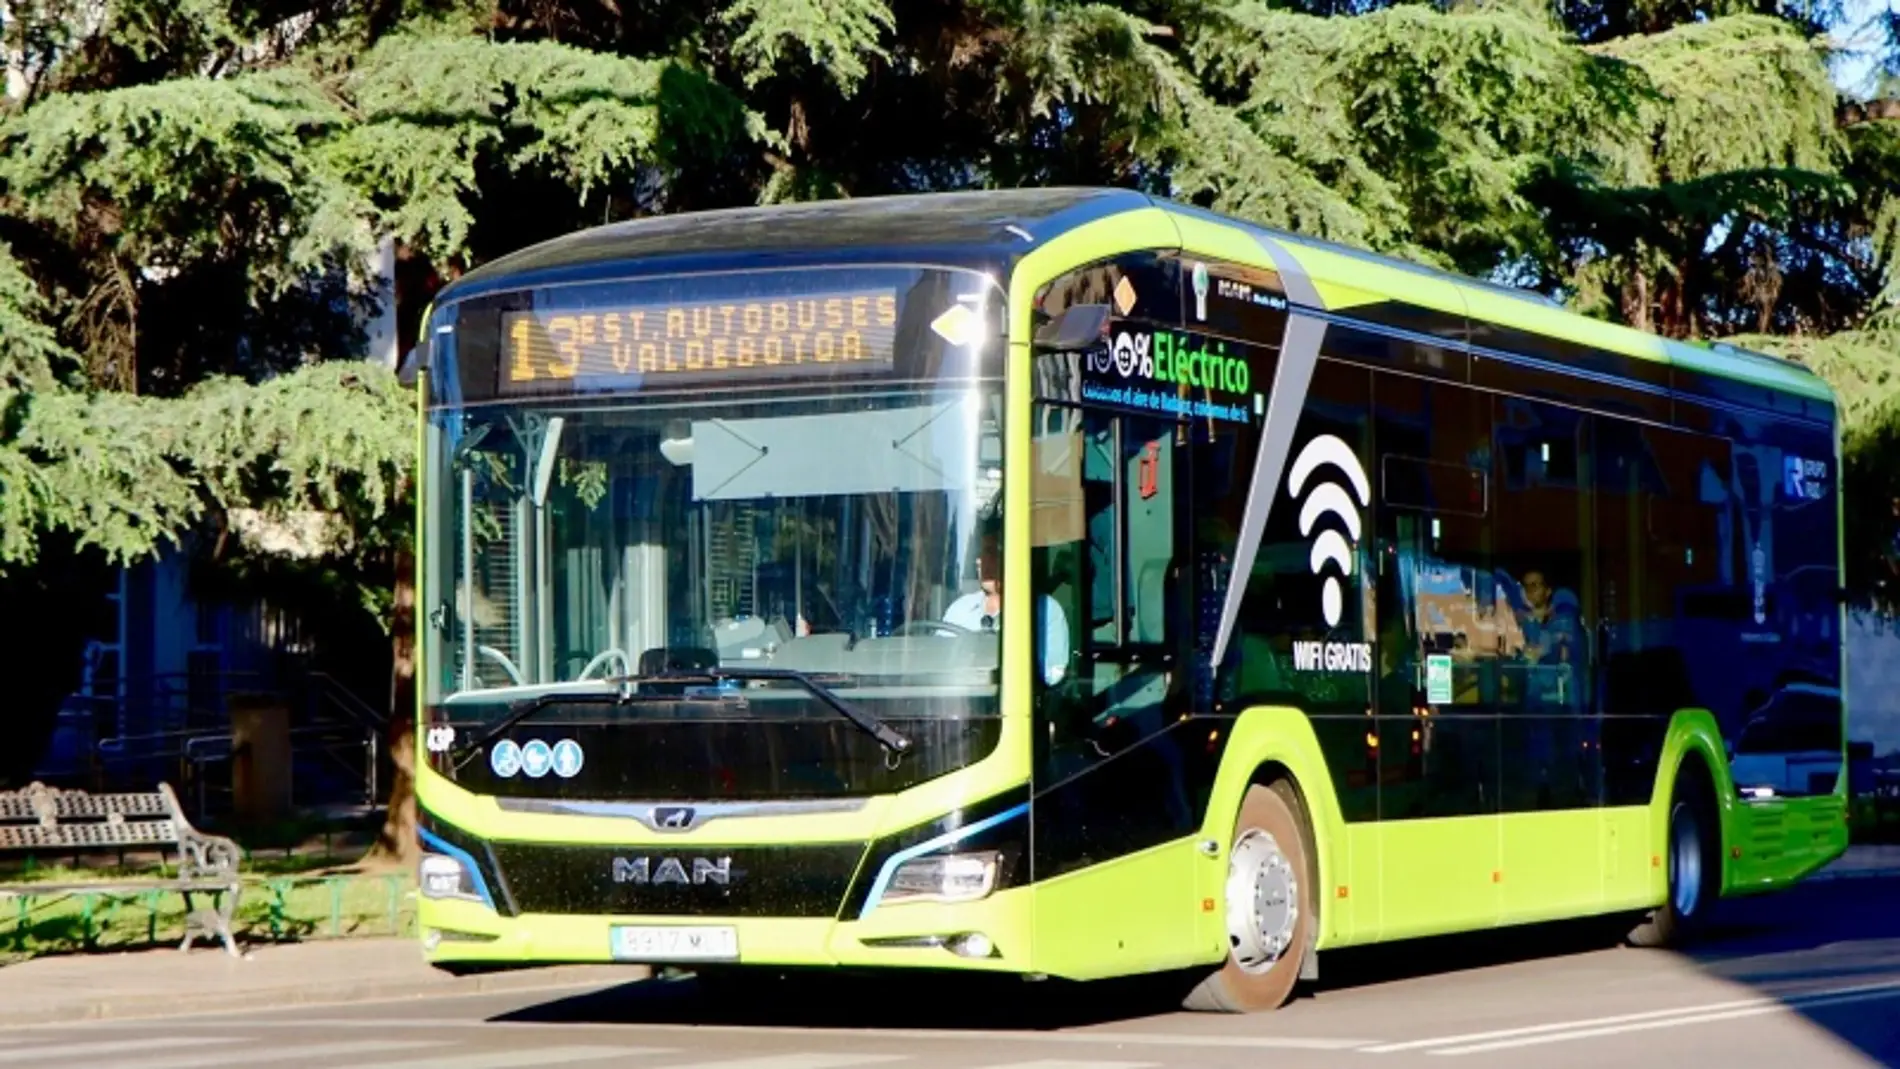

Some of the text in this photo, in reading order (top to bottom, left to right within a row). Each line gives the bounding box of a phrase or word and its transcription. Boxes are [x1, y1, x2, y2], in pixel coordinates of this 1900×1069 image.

[510, 314, 581, 382] 13
[611, 329, 862, 373] VALDEBOTOA
[1153, 331, 1249, 395] Eléctrico
[1293, 640, 1371, 673] WIFI GRATIS
[612, 856, 731, 885] MAN
